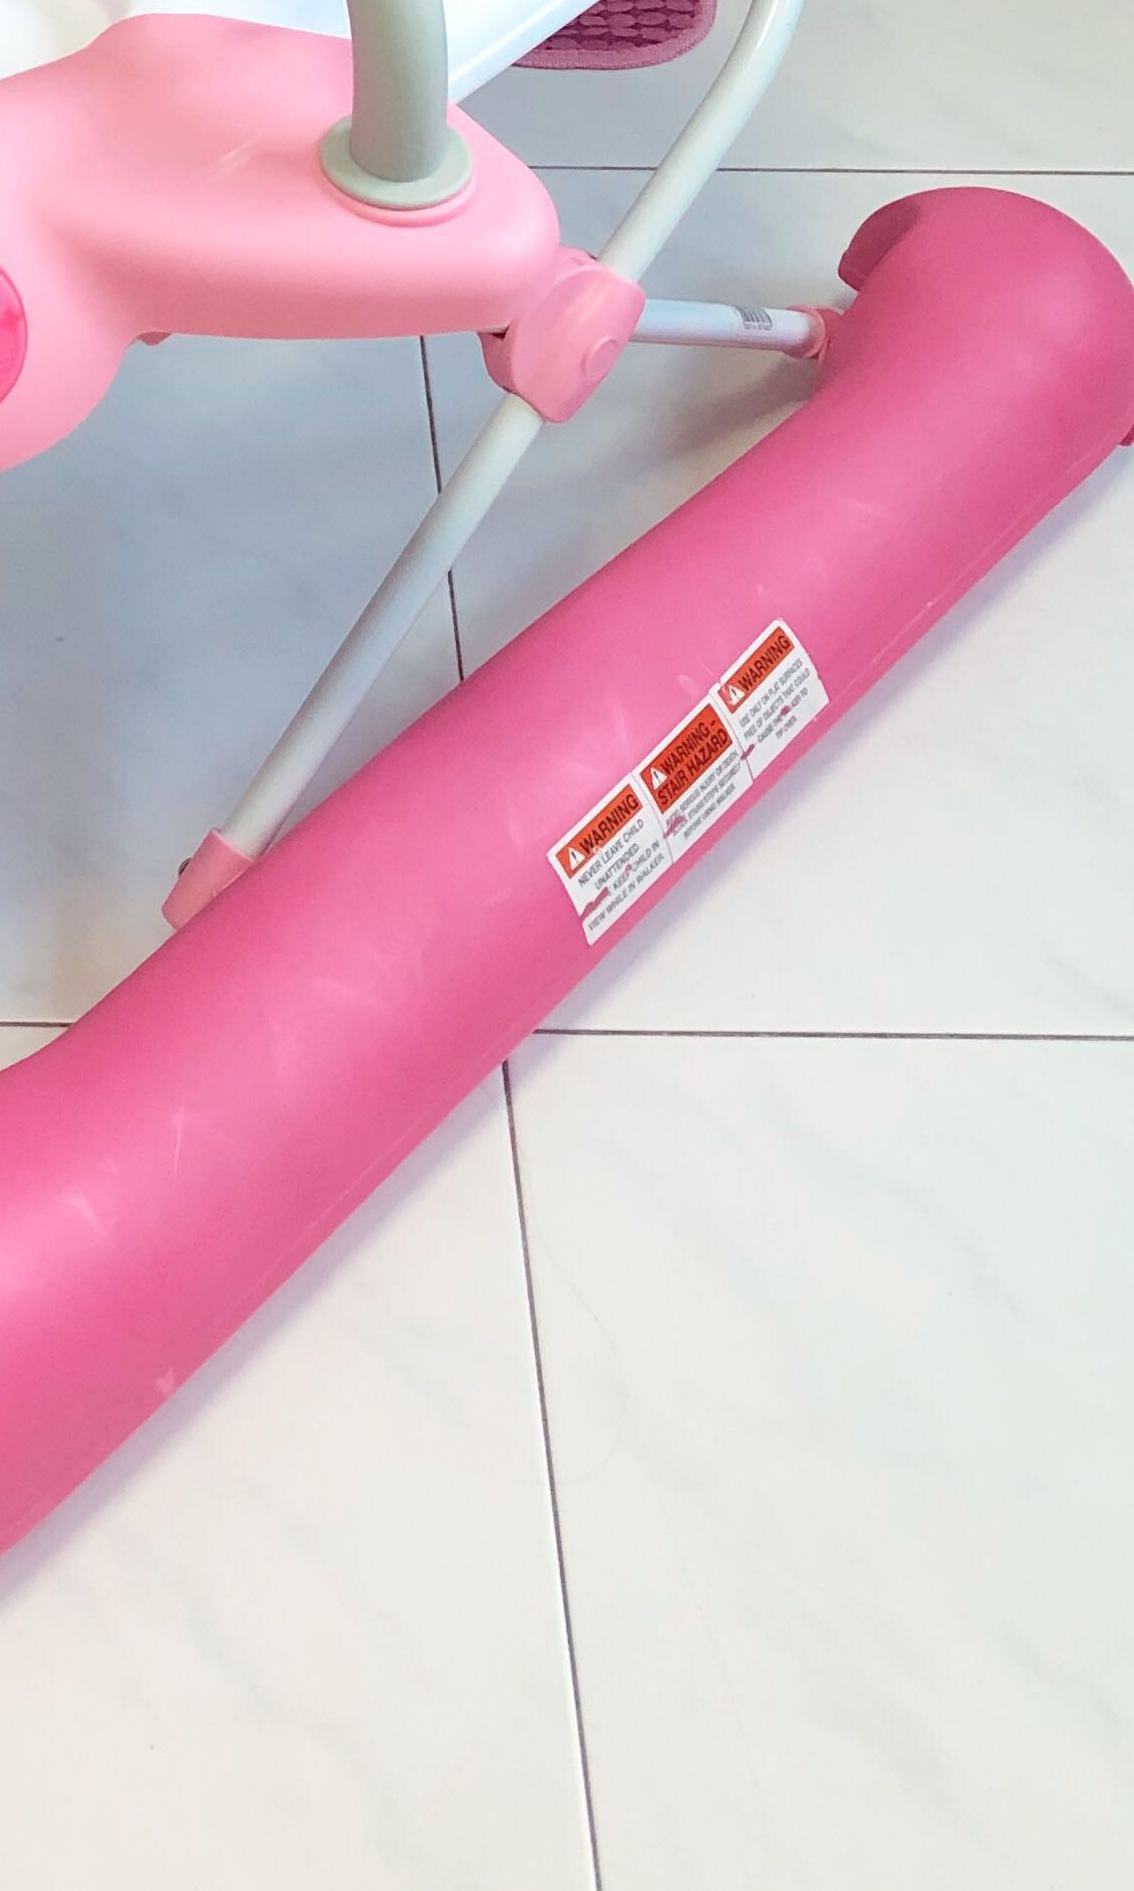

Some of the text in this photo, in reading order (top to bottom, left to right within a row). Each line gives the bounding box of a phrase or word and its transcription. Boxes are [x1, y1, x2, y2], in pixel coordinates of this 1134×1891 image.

[737, 631, 791, 694] WARNING
[656, 767, 689, 807] STAIR
[685, 726, 728, 777] HAZARD
[659, 719, 710, 778] WARNING
[577, 791, 639, 858] WARNING
[577, 859, 602, 887] NEVER
[601, 838, 624, 864] LEAVE
[621, 817, 644, 844] CHILD
[588, 910, 606, 931] VIEW
[635, 851, 664, 884] WALKER
[593, 841, 639, 890] UNATTENDED
